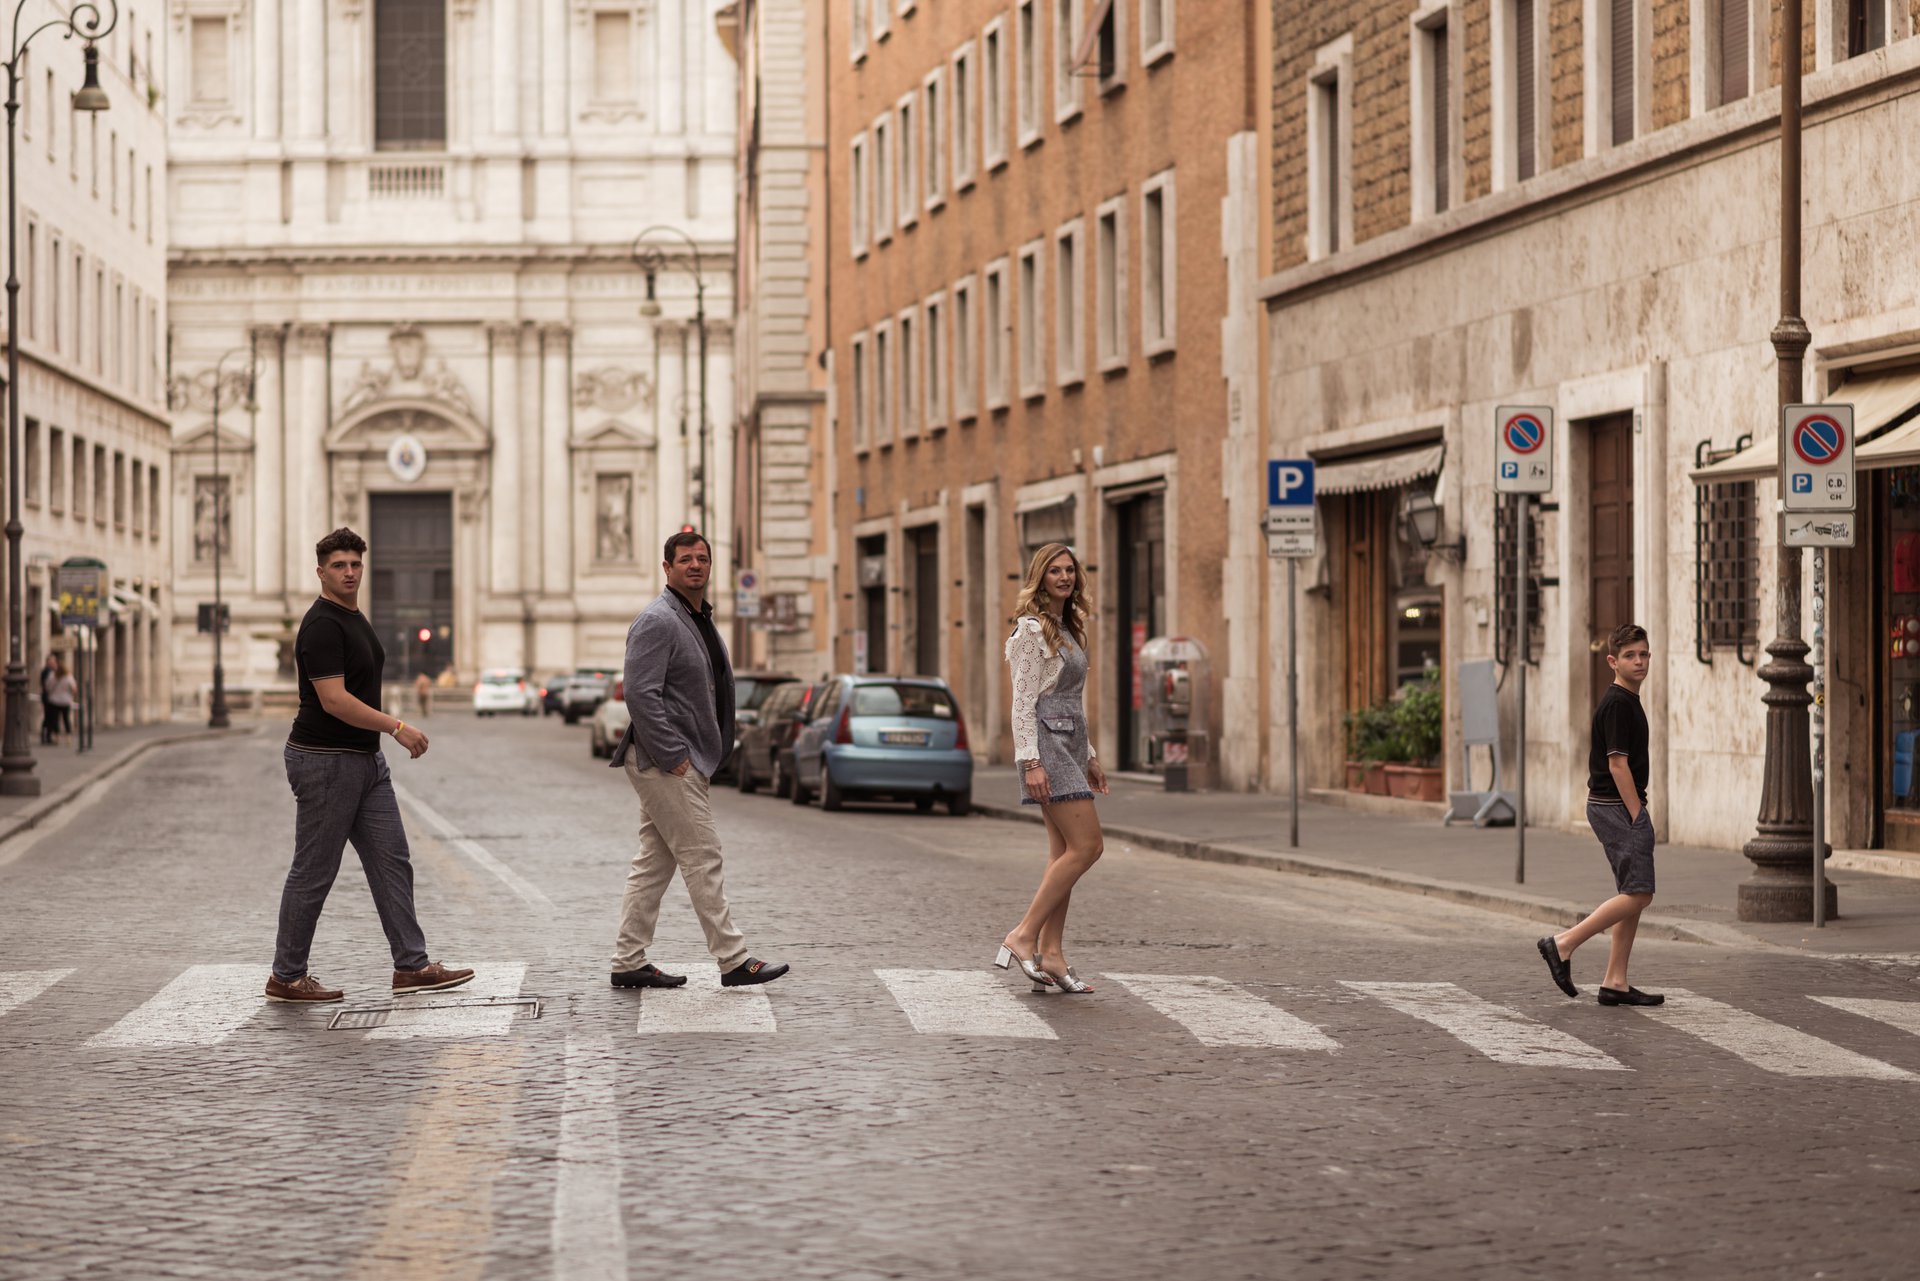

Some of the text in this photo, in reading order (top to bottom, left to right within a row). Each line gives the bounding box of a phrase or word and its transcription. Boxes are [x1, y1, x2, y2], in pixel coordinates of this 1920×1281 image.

[1504, 463, 1516, 478] P
[1278, 466, 1304, 500] P
[1795, 475, 1809, 492] P
[1828, 478, 1846, 488] C.D.
[1829, 493, 1842, 501] CH
